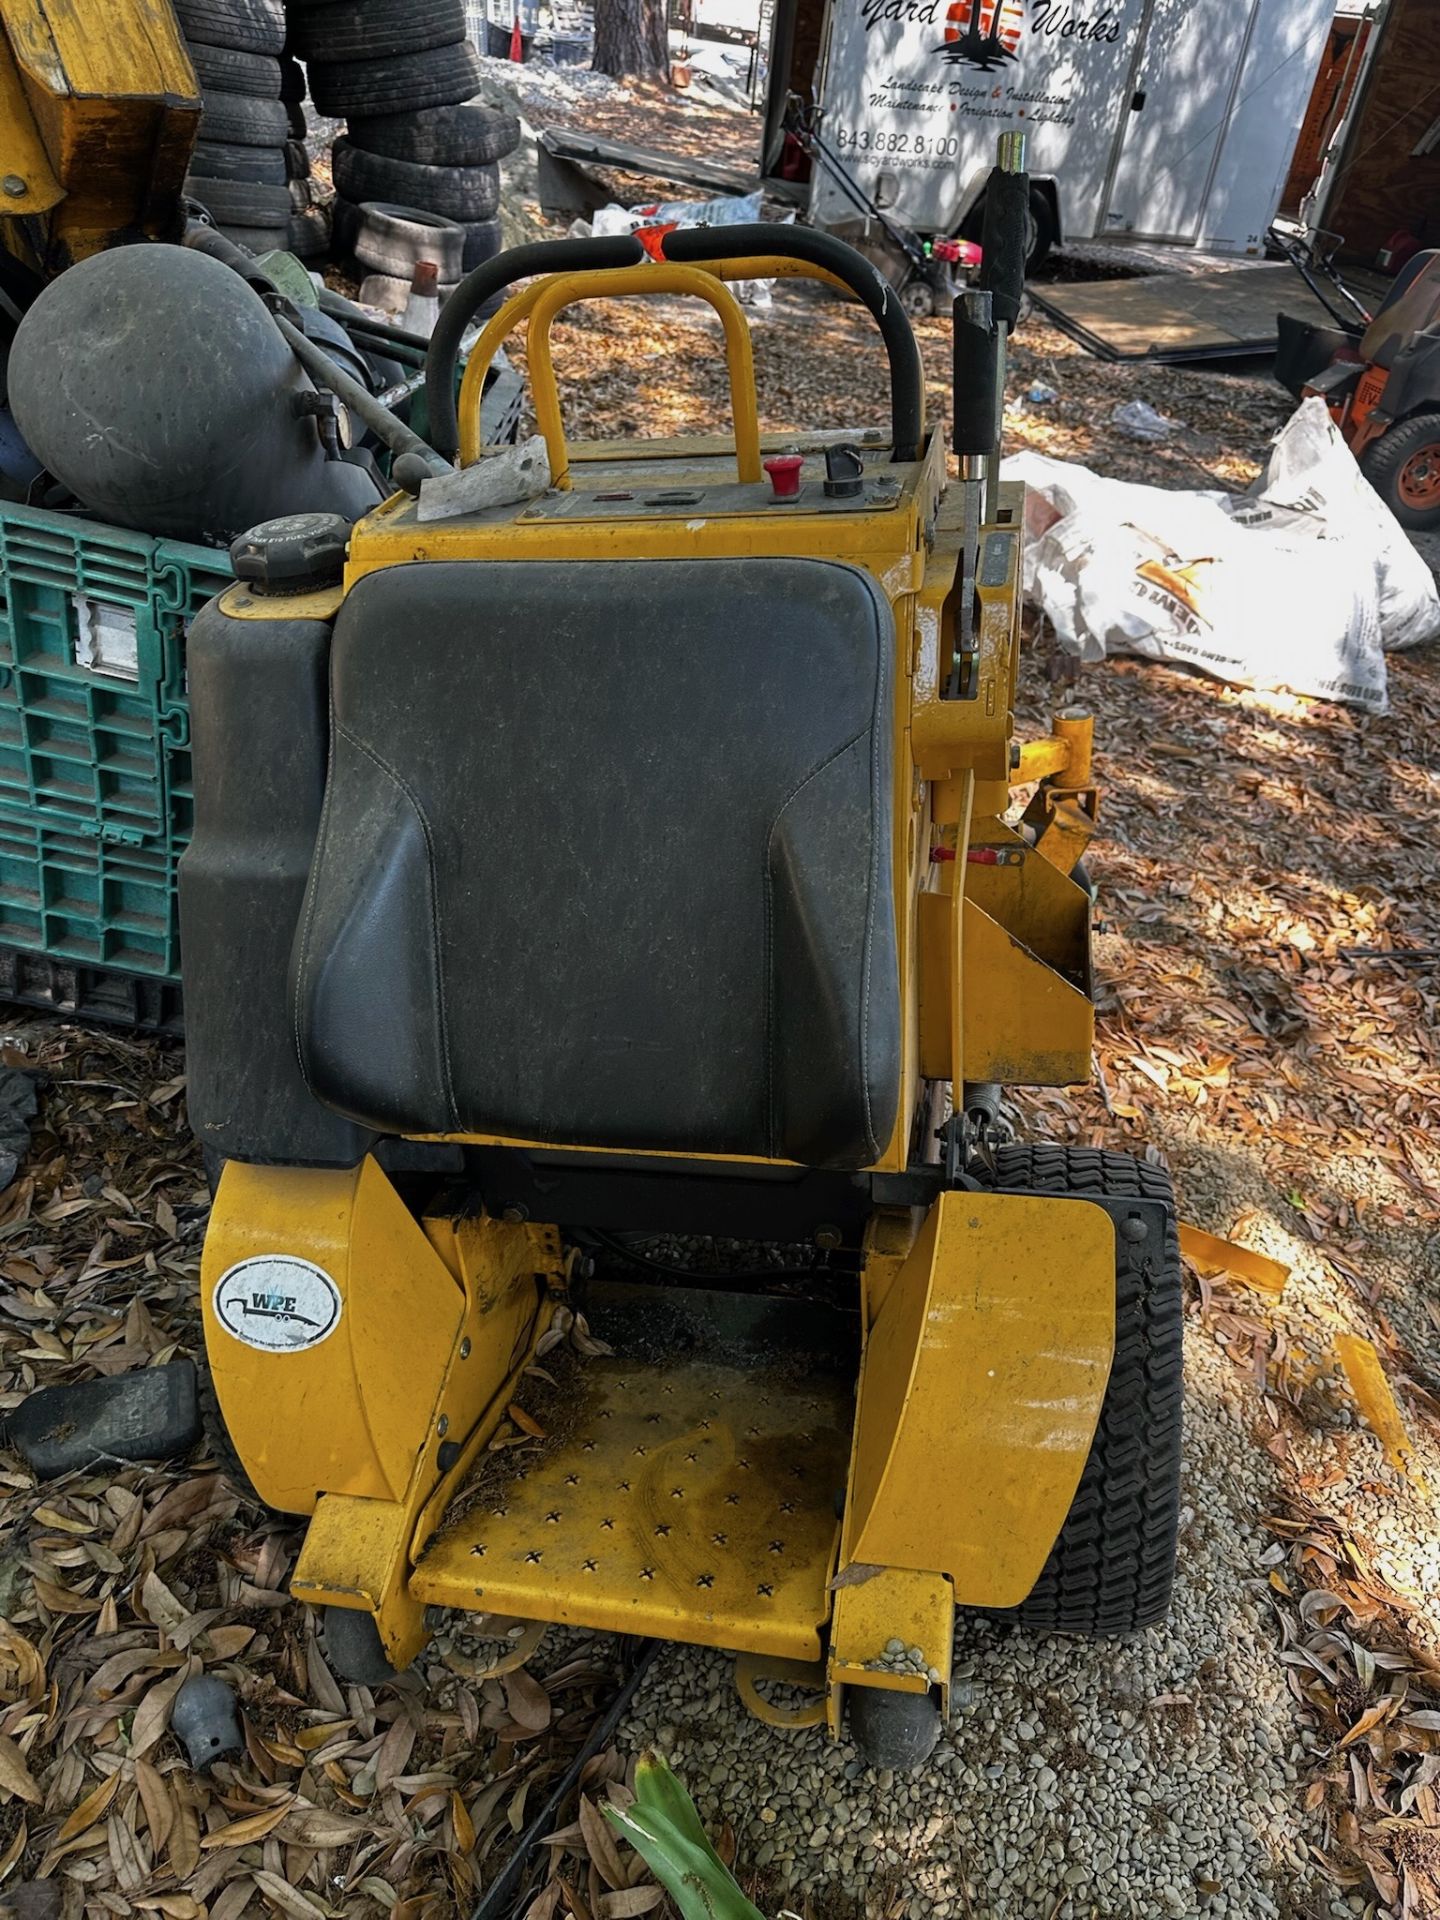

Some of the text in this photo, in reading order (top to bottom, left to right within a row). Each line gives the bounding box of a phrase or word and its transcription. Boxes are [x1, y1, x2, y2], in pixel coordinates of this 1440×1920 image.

[1031, 0, 1121, 43] Works
[880, 76, 943, 95] Landscape
[948, 81, 987, 101] Design
[1006, 87, 1071, 106] Installation
[960, 102, 1013, 120] Irrigation
[1027, 108, 1075, 128] Lighting
[836, 129, 958, 156] 843.882.8100
[252, 1293, 297, 1312] WPE
